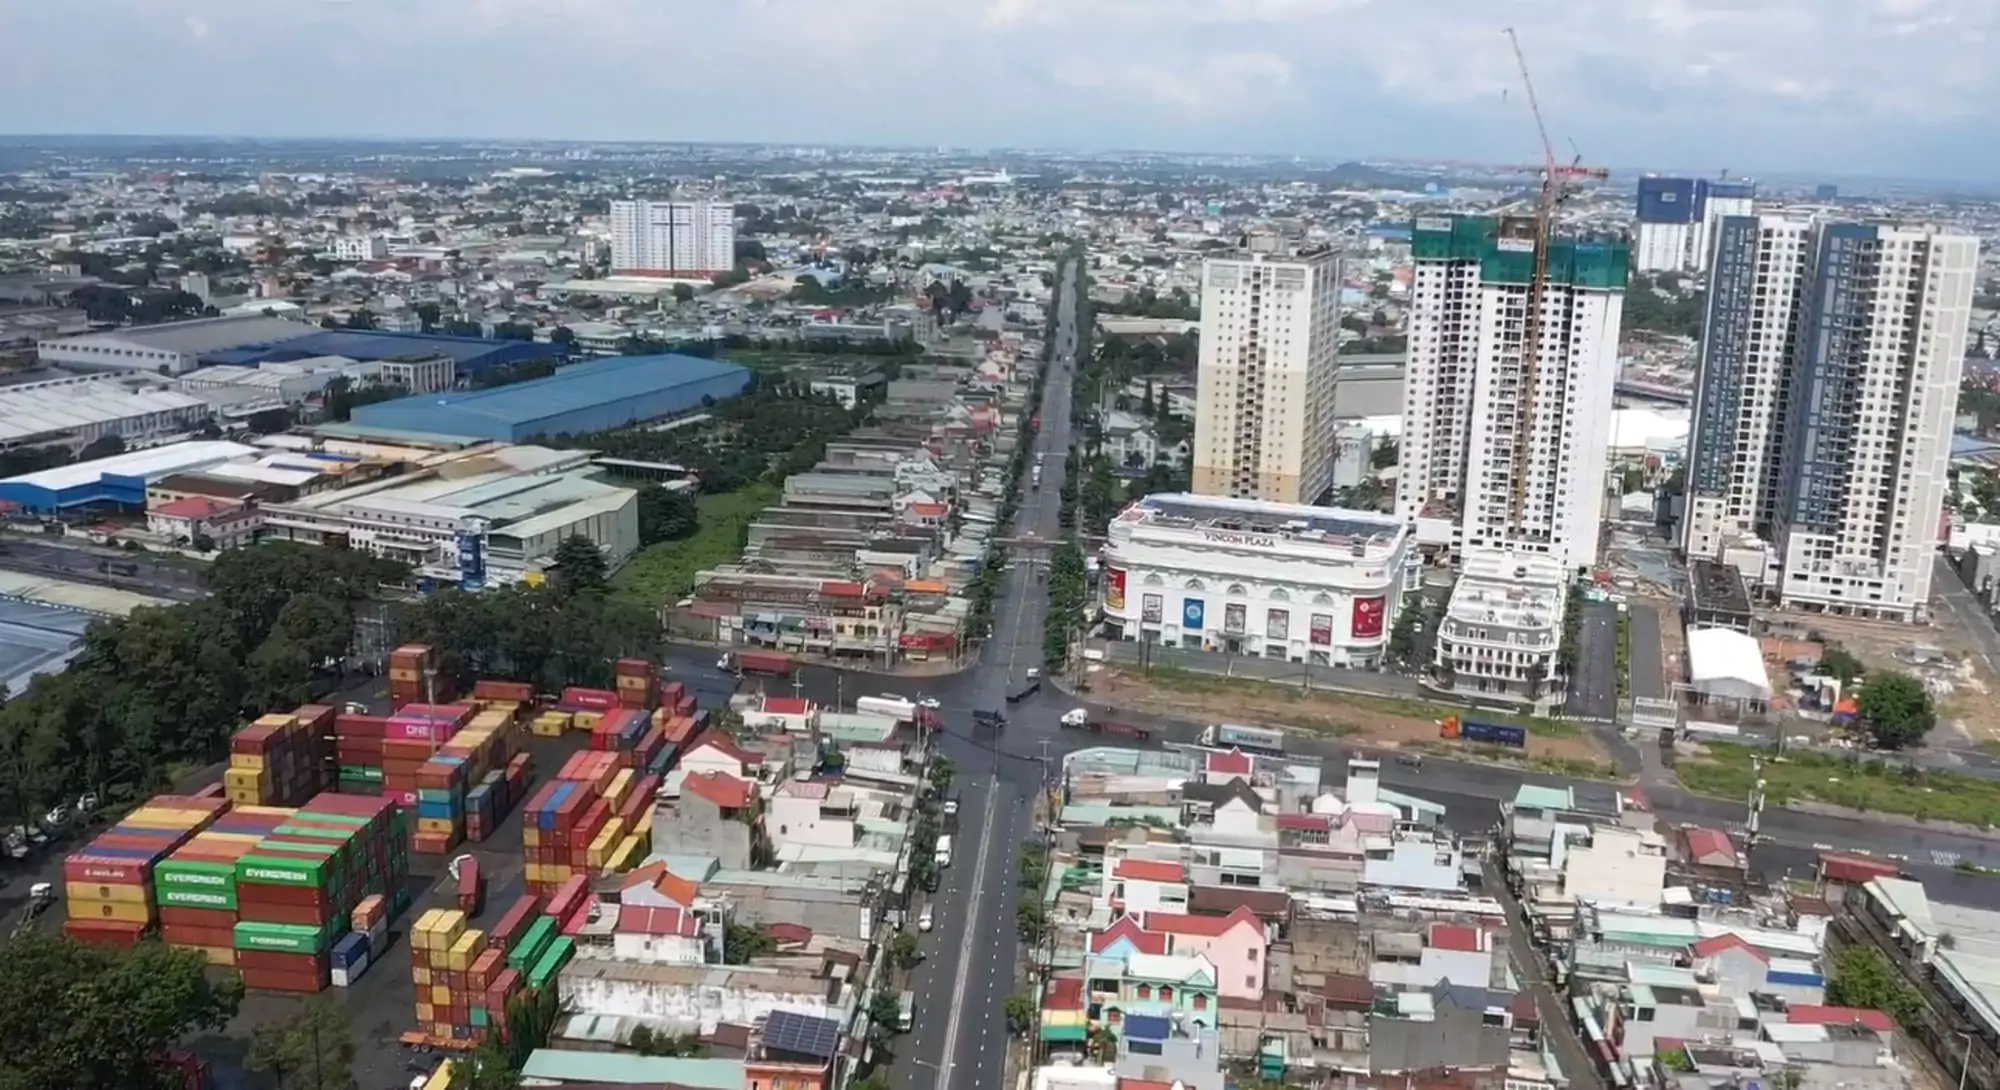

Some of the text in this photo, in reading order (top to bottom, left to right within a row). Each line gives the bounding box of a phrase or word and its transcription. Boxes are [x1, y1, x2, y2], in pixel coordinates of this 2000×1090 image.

[1245, 536, 1275, 548] PLAZA
[405, 724, 430, 738] ONE
[164, 873, 225, 885] EVERGREEN
[245, 868, 307, 881] EVERGREEN
[167, 892, 227, 904] EVERGREEN
